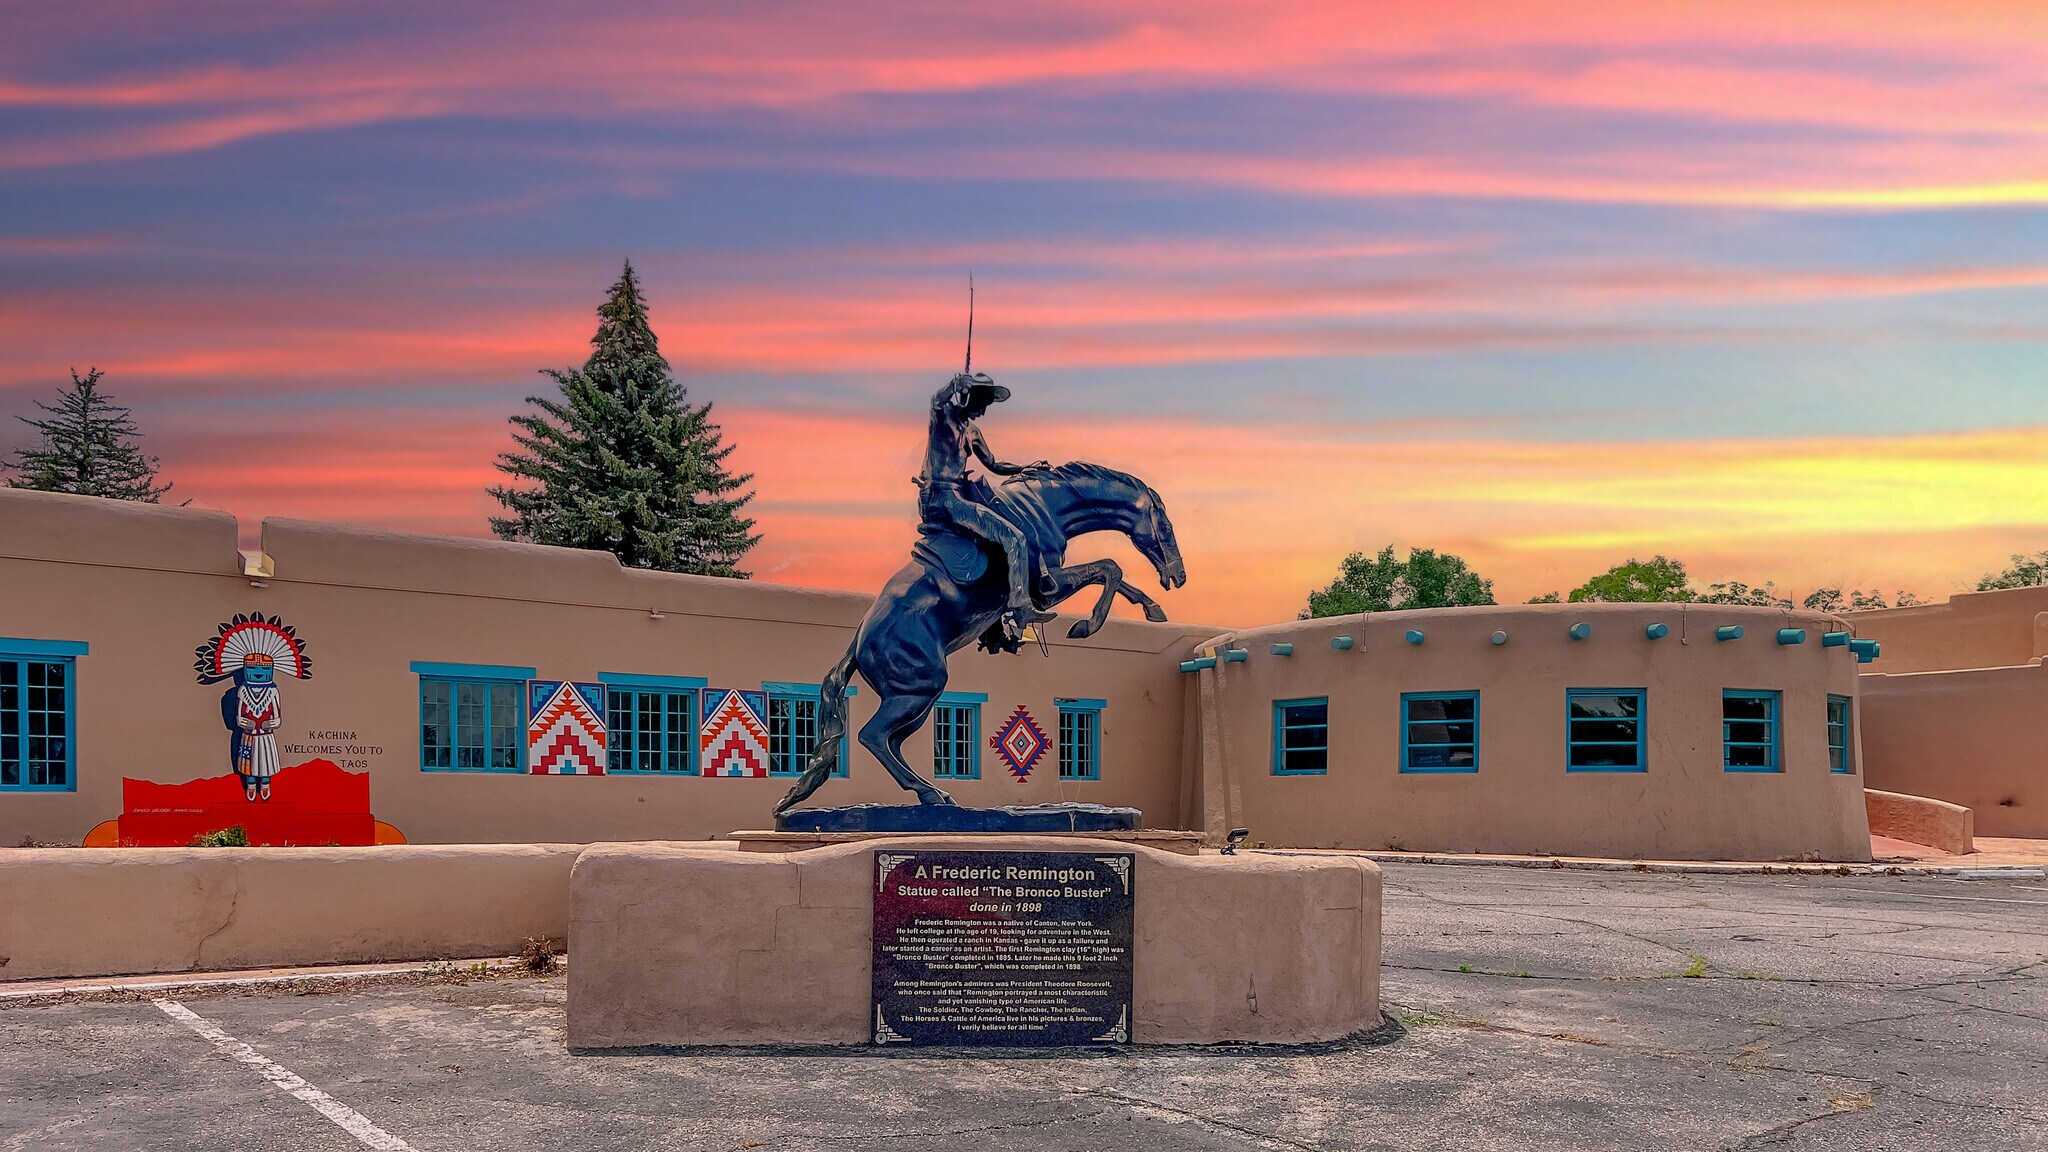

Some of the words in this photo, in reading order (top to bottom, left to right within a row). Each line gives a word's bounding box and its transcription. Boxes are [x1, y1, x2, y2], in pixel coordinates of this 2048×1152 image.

[308, 730, 357, 740] KACHINA
[284, 743, 342, 754] WELCOMES
[345, 744, 366, 755] YOU
[369, 746, 383, 755] TO
[340, 759, 368, 768] TAOS
[915, 865, 928, 879] A
[932, 866, 1001, 879] Frederic
[1006, 866, 1094, 883] Remington
[898, 886, 938, 896] Statue
[942, 886, 979, 896] called
[983, 886, 1012, 897] “The
[1016, 887, 1060, 897] Bronco
[1064, 887, 1111, 898] Buster”
[969, 902, 998, 912] done
[1001, 902, 1012, 912] in
[1015, 902, 1042, 912] 1898
[966, 929, 979, 937] age
[1023, 938, 1040, 946] gave
[1061, 946, 1076, 954] clay
[920, 980, 963, 988] Remington's
[952, 998, 963, 1006] yet
